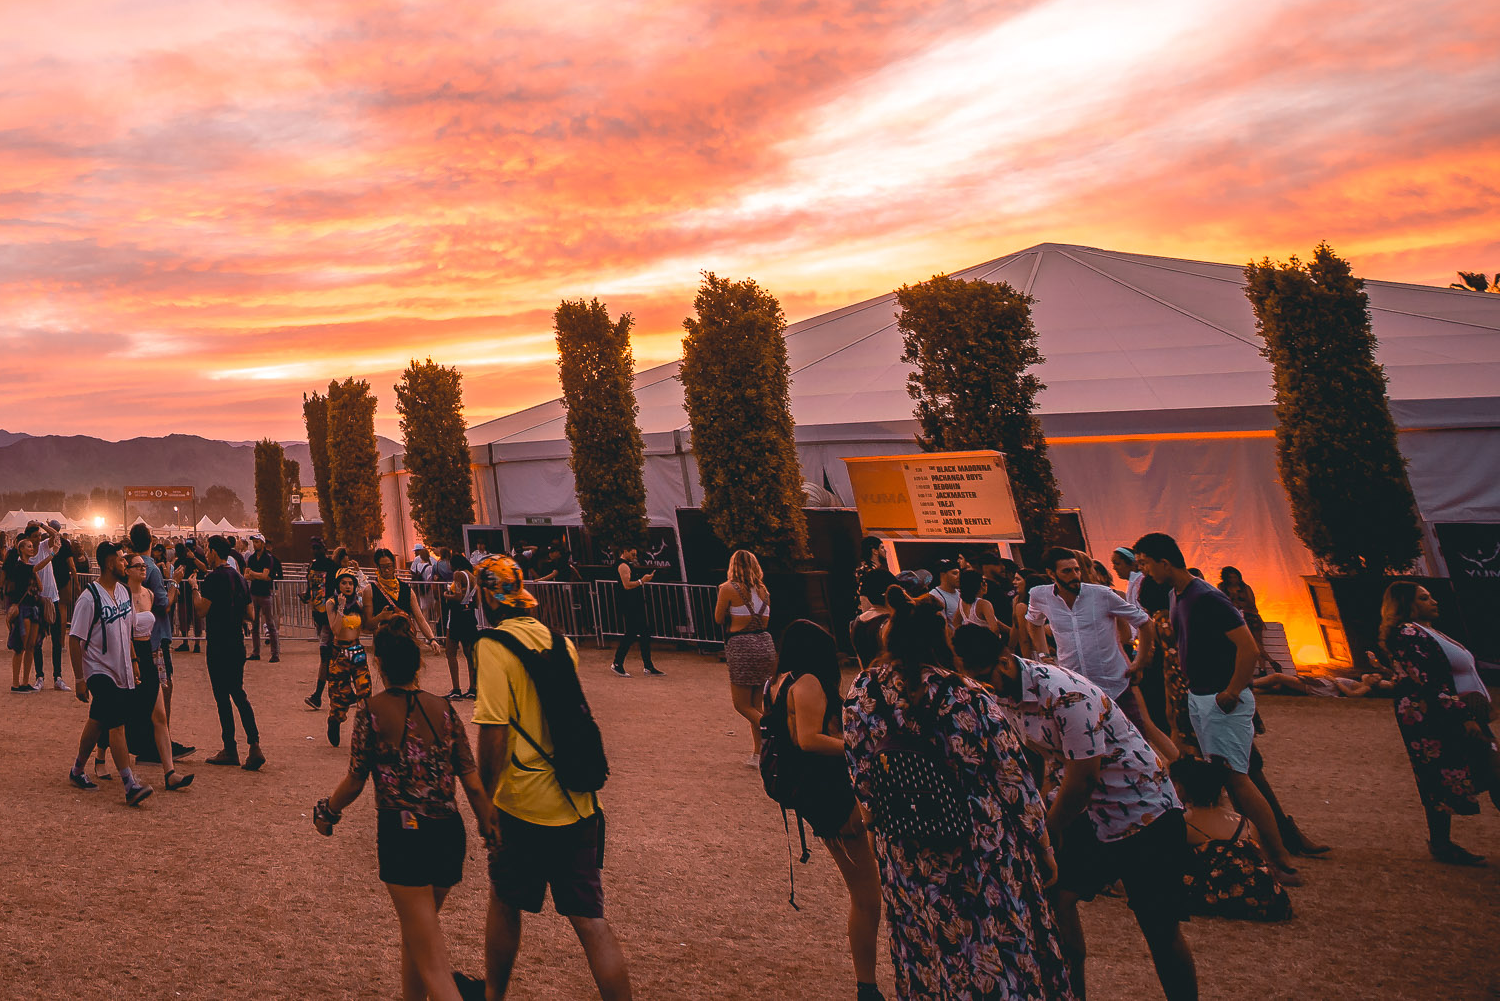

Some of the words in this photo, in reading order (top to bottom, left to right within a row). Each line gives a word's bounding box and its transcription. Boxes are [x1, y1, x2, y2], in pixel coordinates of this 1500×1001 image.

[936, 465, 957, 473] BLACK
[957, 464, 992, 472] MADONNA
[931, 474, 965, 482] PACHANGA
[965, 473, 984, 481] BOYS
[932, 483, 961, 491] BEDOUIN
[860, 493, 908, 505] YUMA
[935, 491, 977, 499] JACKMASTER
[936, 500, 955, 508] YAEJI
[942, 518, 963, 526] JASON
[963, 517, 992, 526] BENTLEY
[943, 526, 966, 534] SAHAR
[644, 559, 671, 567] YUMA
